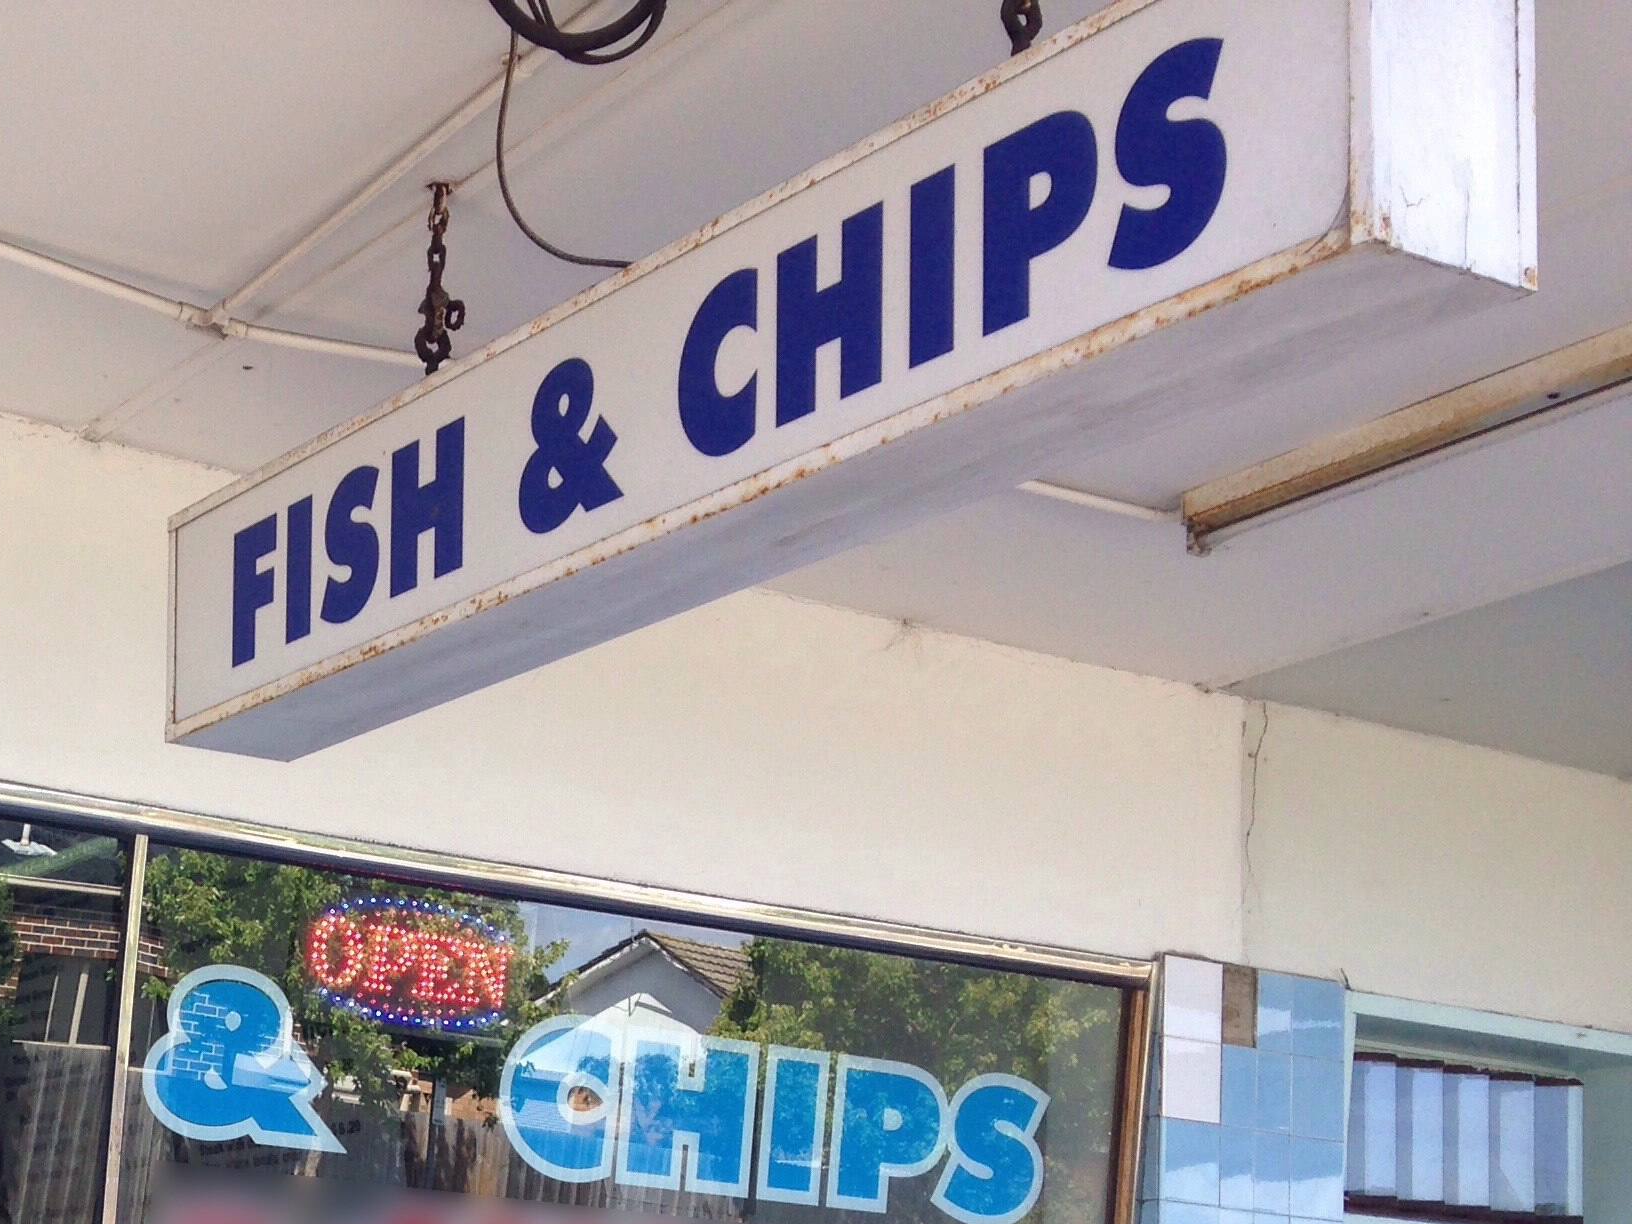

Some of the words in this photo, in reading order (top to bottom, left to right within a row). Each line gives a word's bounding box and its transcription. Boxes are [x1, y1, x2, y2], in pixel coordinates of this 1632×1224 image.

[231, 414, 466, 669] FISH
[517, 356, 625, 535] &
[678, 37, 1227, 458] CHIPS
[308, 913, 511, 1011] OPEN
[144, 963, 347, 1154] &
